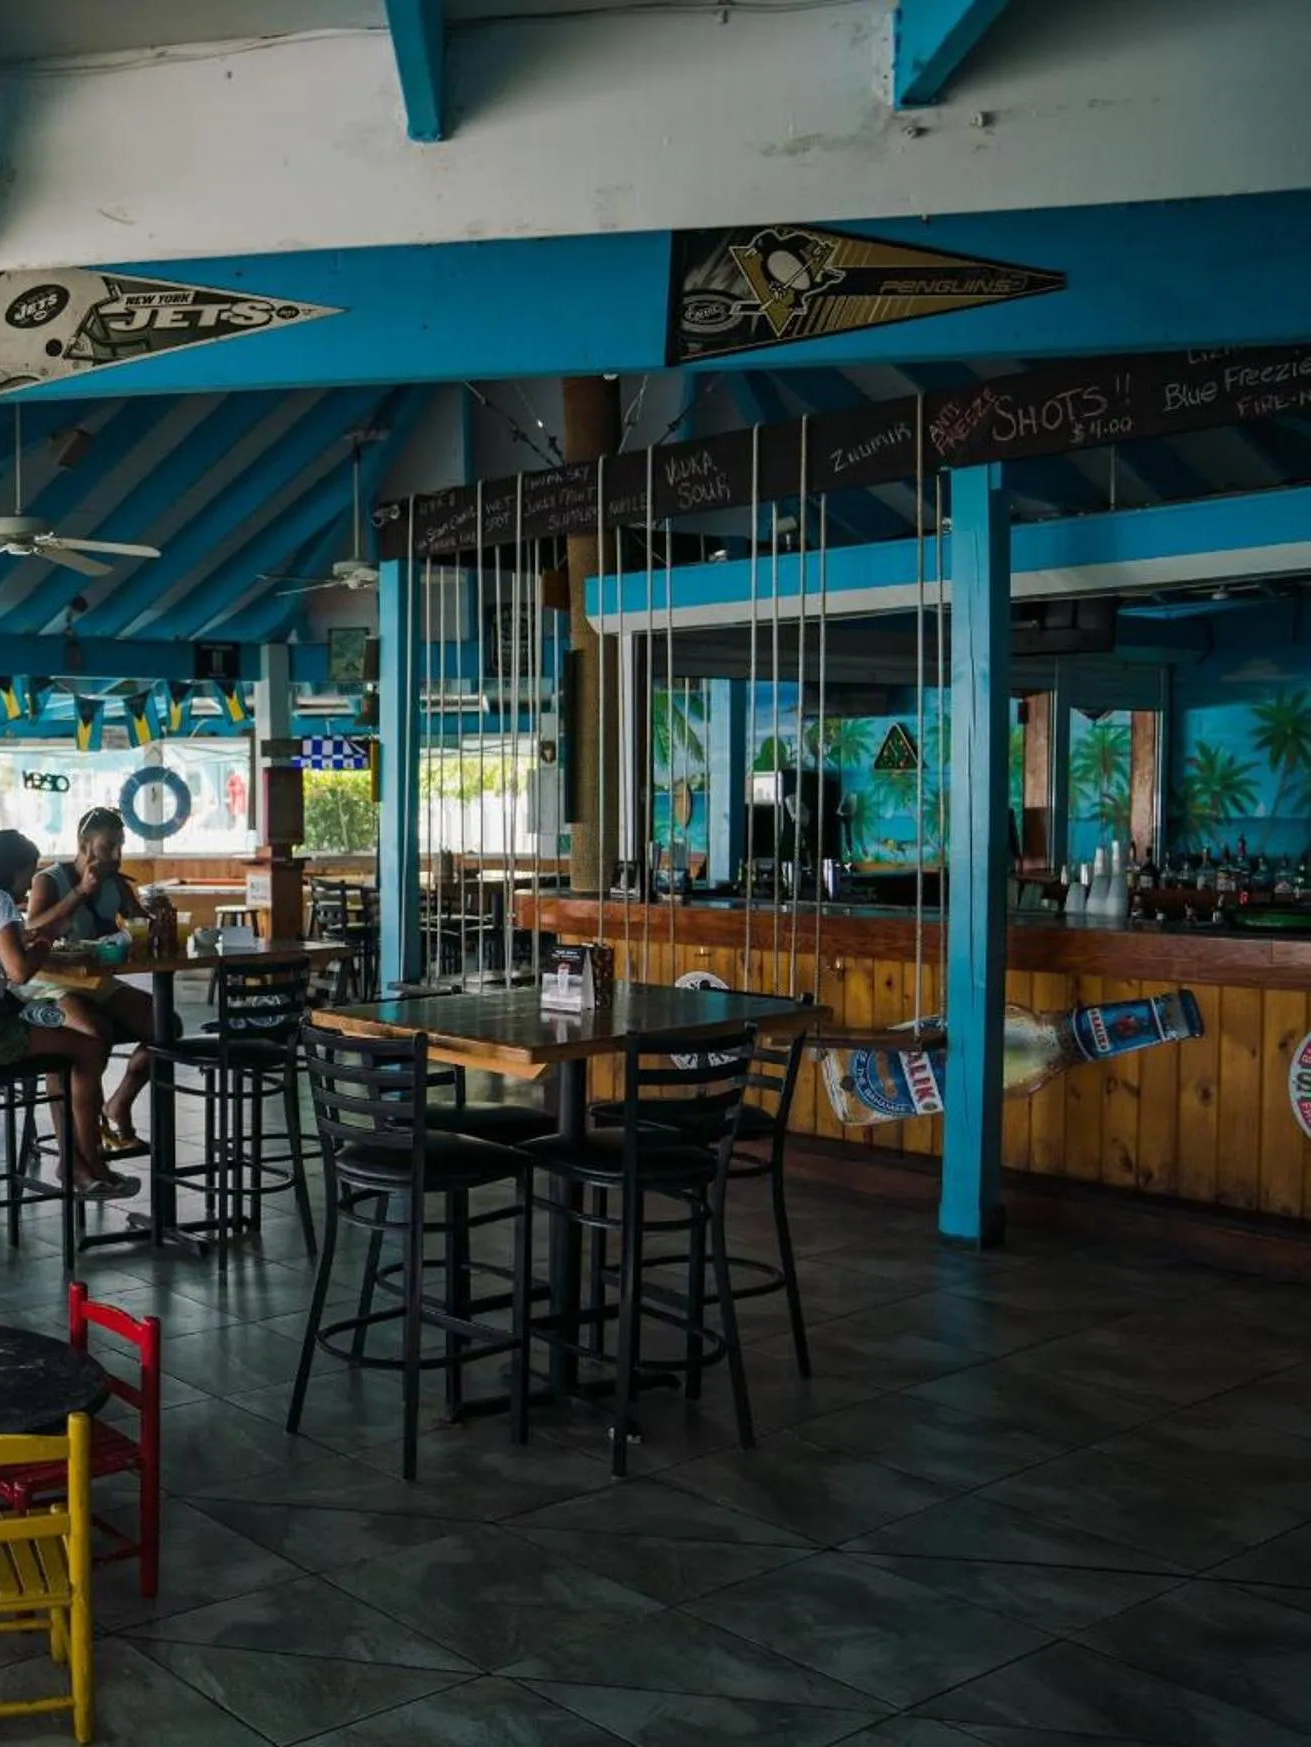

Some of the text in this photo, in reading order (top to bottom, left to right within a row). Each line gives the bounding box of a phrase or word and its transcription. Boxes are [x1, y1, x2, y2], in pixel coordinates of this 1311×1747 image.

[13, 293, 58, 321] JETS
[125, 292, 190, 305] NEW YORK
[107, 300, 275, 332] JETS
[1163, 381, 1218, 412] Blue
